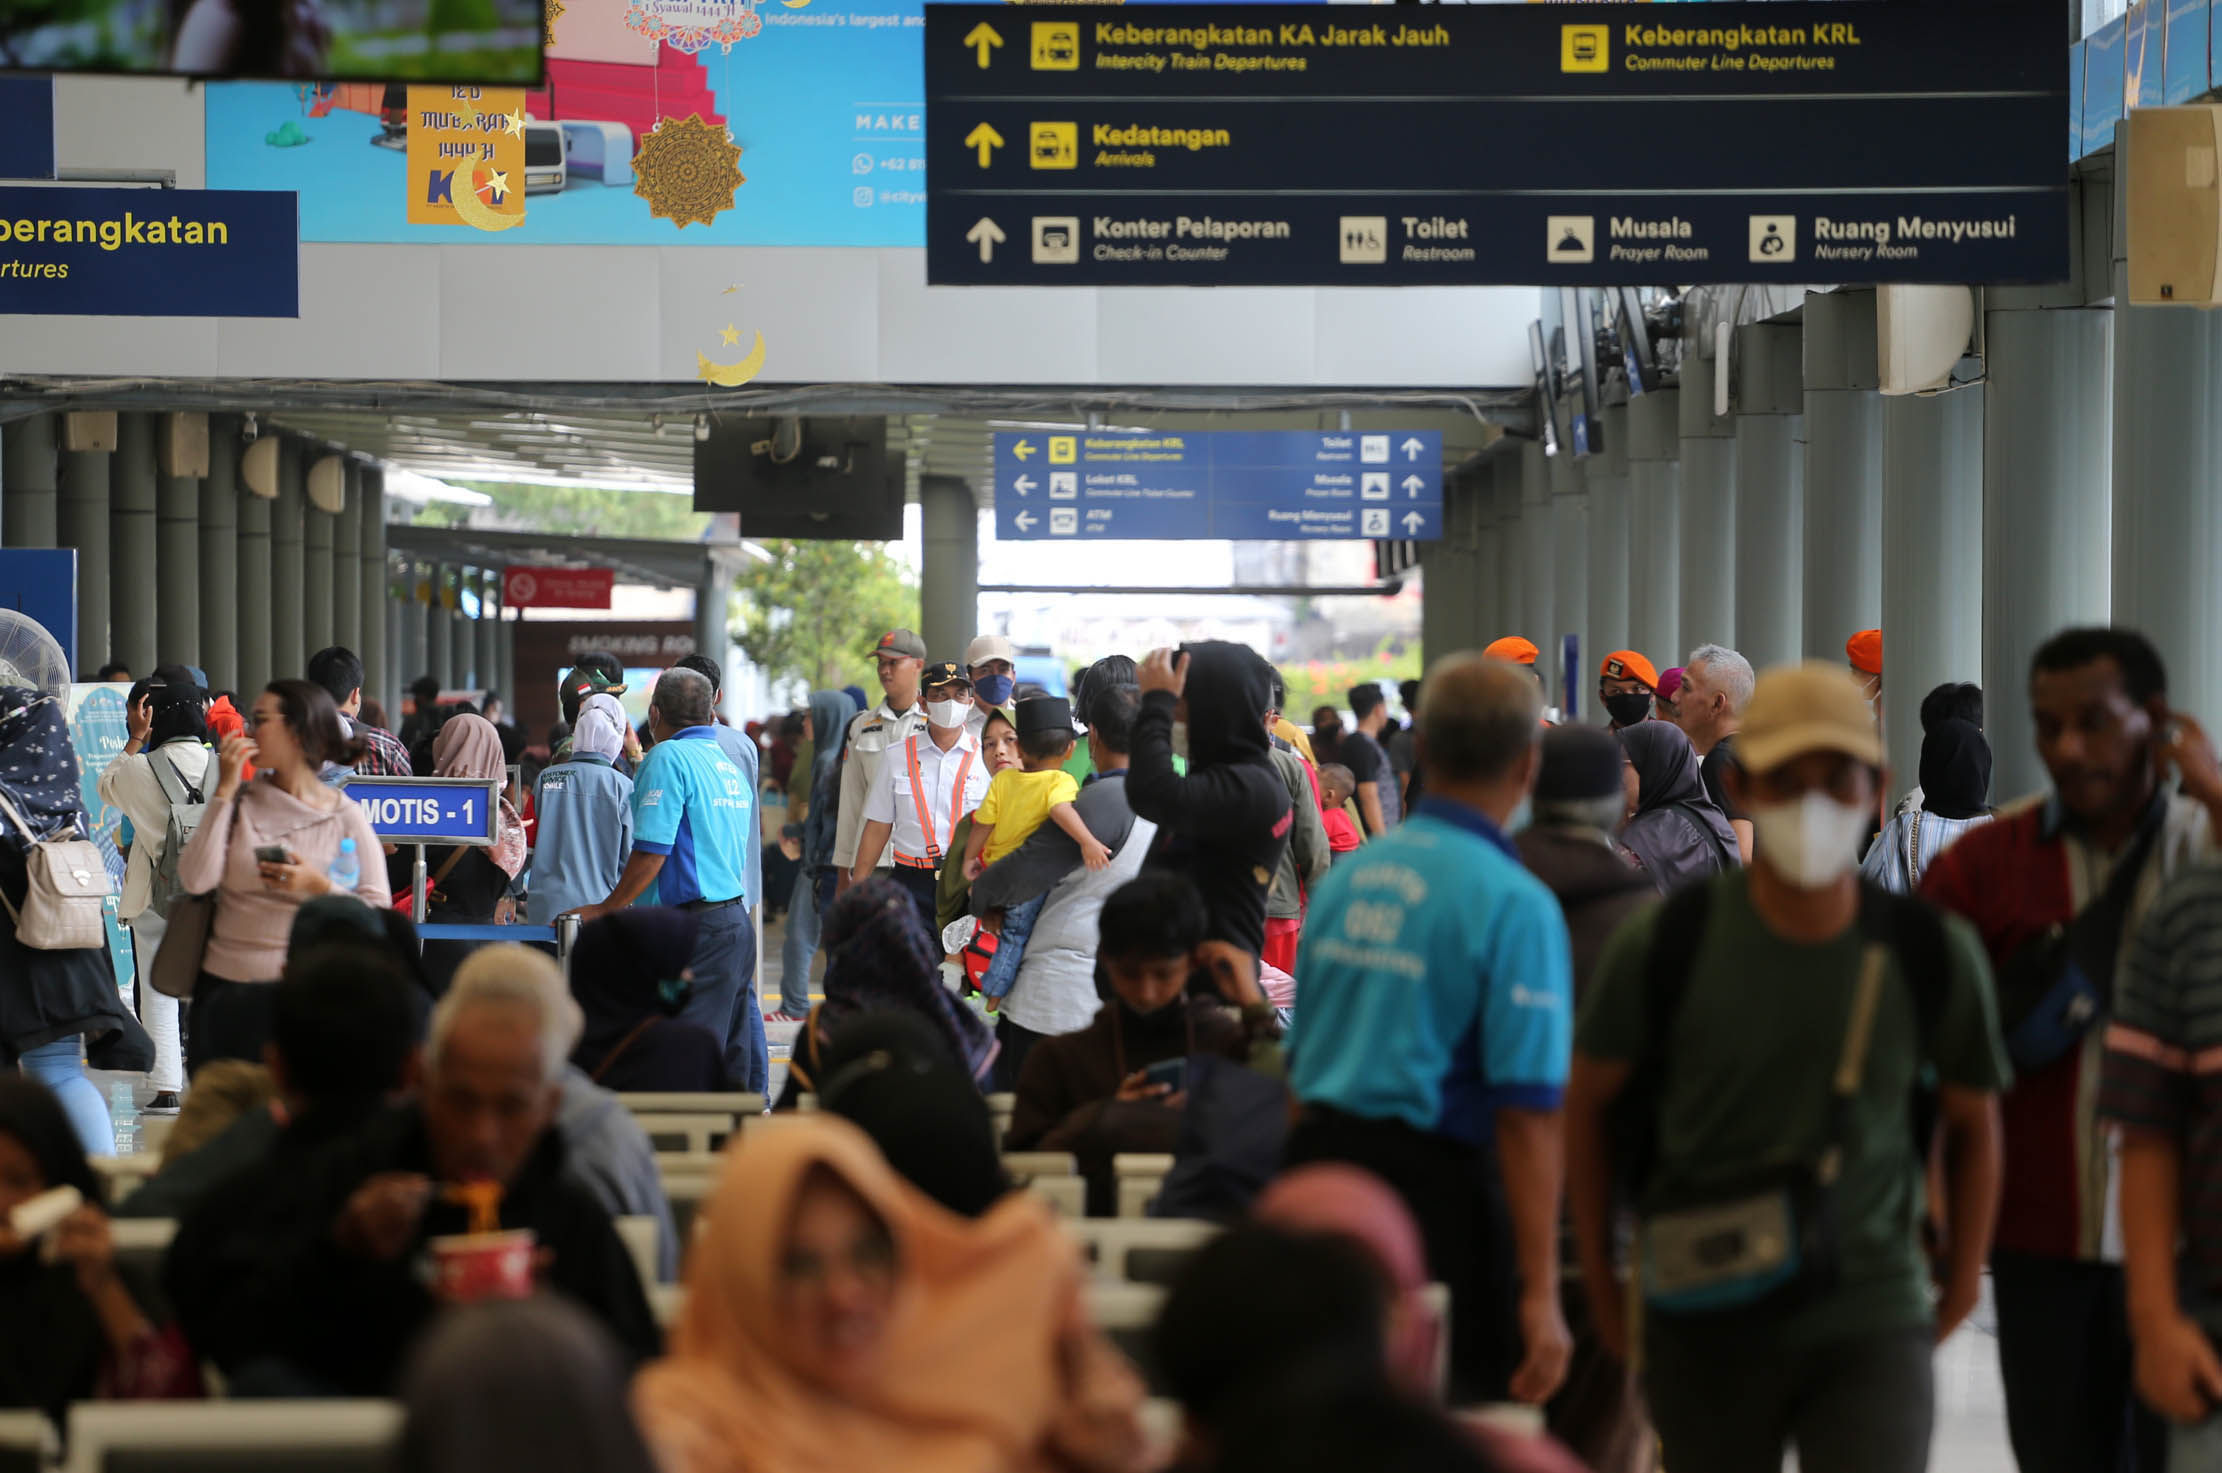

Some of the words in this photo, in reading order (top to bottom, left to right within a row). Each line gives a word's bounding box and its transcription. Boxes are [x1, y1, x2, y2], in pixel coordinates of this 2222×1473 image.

[652, 1, 693, 14] Syawal
[765, 12, 846, 26] Indonesia's
[849, 12, 900, 29] largest
[1096, 22, 1273, 50] Keberangkatan
[1279, 24, 1316, 46] KA
[1320, 24, 1387, 46] Jarak
[1391, 24, 1450, 46] Jauh
[1625, 23, 1806, 51] Keberangkatan
[1813, 22, 1861, 45] KRL
[1096, 52, 1167, 74] Intercity
[1170, 52, 1212, 71] Train
[1214, 52, 1308, 74] Departures
[1625, 53, 1708, 72] Commuter
[1711, 53, 1745, 72] Line
[1748, 53, 1835, 74] Departures
[855, 113, 921, 131] MAKE
[1093, 123, 1231, 151] Kedatangan
[1094, 150, 1156, 167] Arrivals
[1093, 216, 1172, 238] Konter
[1176, 216, 1290, 243] Pelaporan
[1401, 216, 1469, 239] Toilet
[1610, 216, 1692, 239] Musala
[1815, 216, 1891, 243] Ruang
[1897, 214, 2015, 243] Menyusui
[1093, 243, 1164, 261] Check-in
[1165, 243, 1229, 261] Counter
[1402, 244, 1475, 262] Restroom
[1609, 243, 1661, 264] Prayer
[1664, 243, 1709, 262] Room
[1814, 243, 1873, 261] Nursery
[1876, 243, 1919, 259] Room
[1086, 509, 1113, 521] ATM
[567, 635, 658, 656] SMOKING
[360, 798, 440, 825] MOTIS
[462, 798, 473, 825] 1
